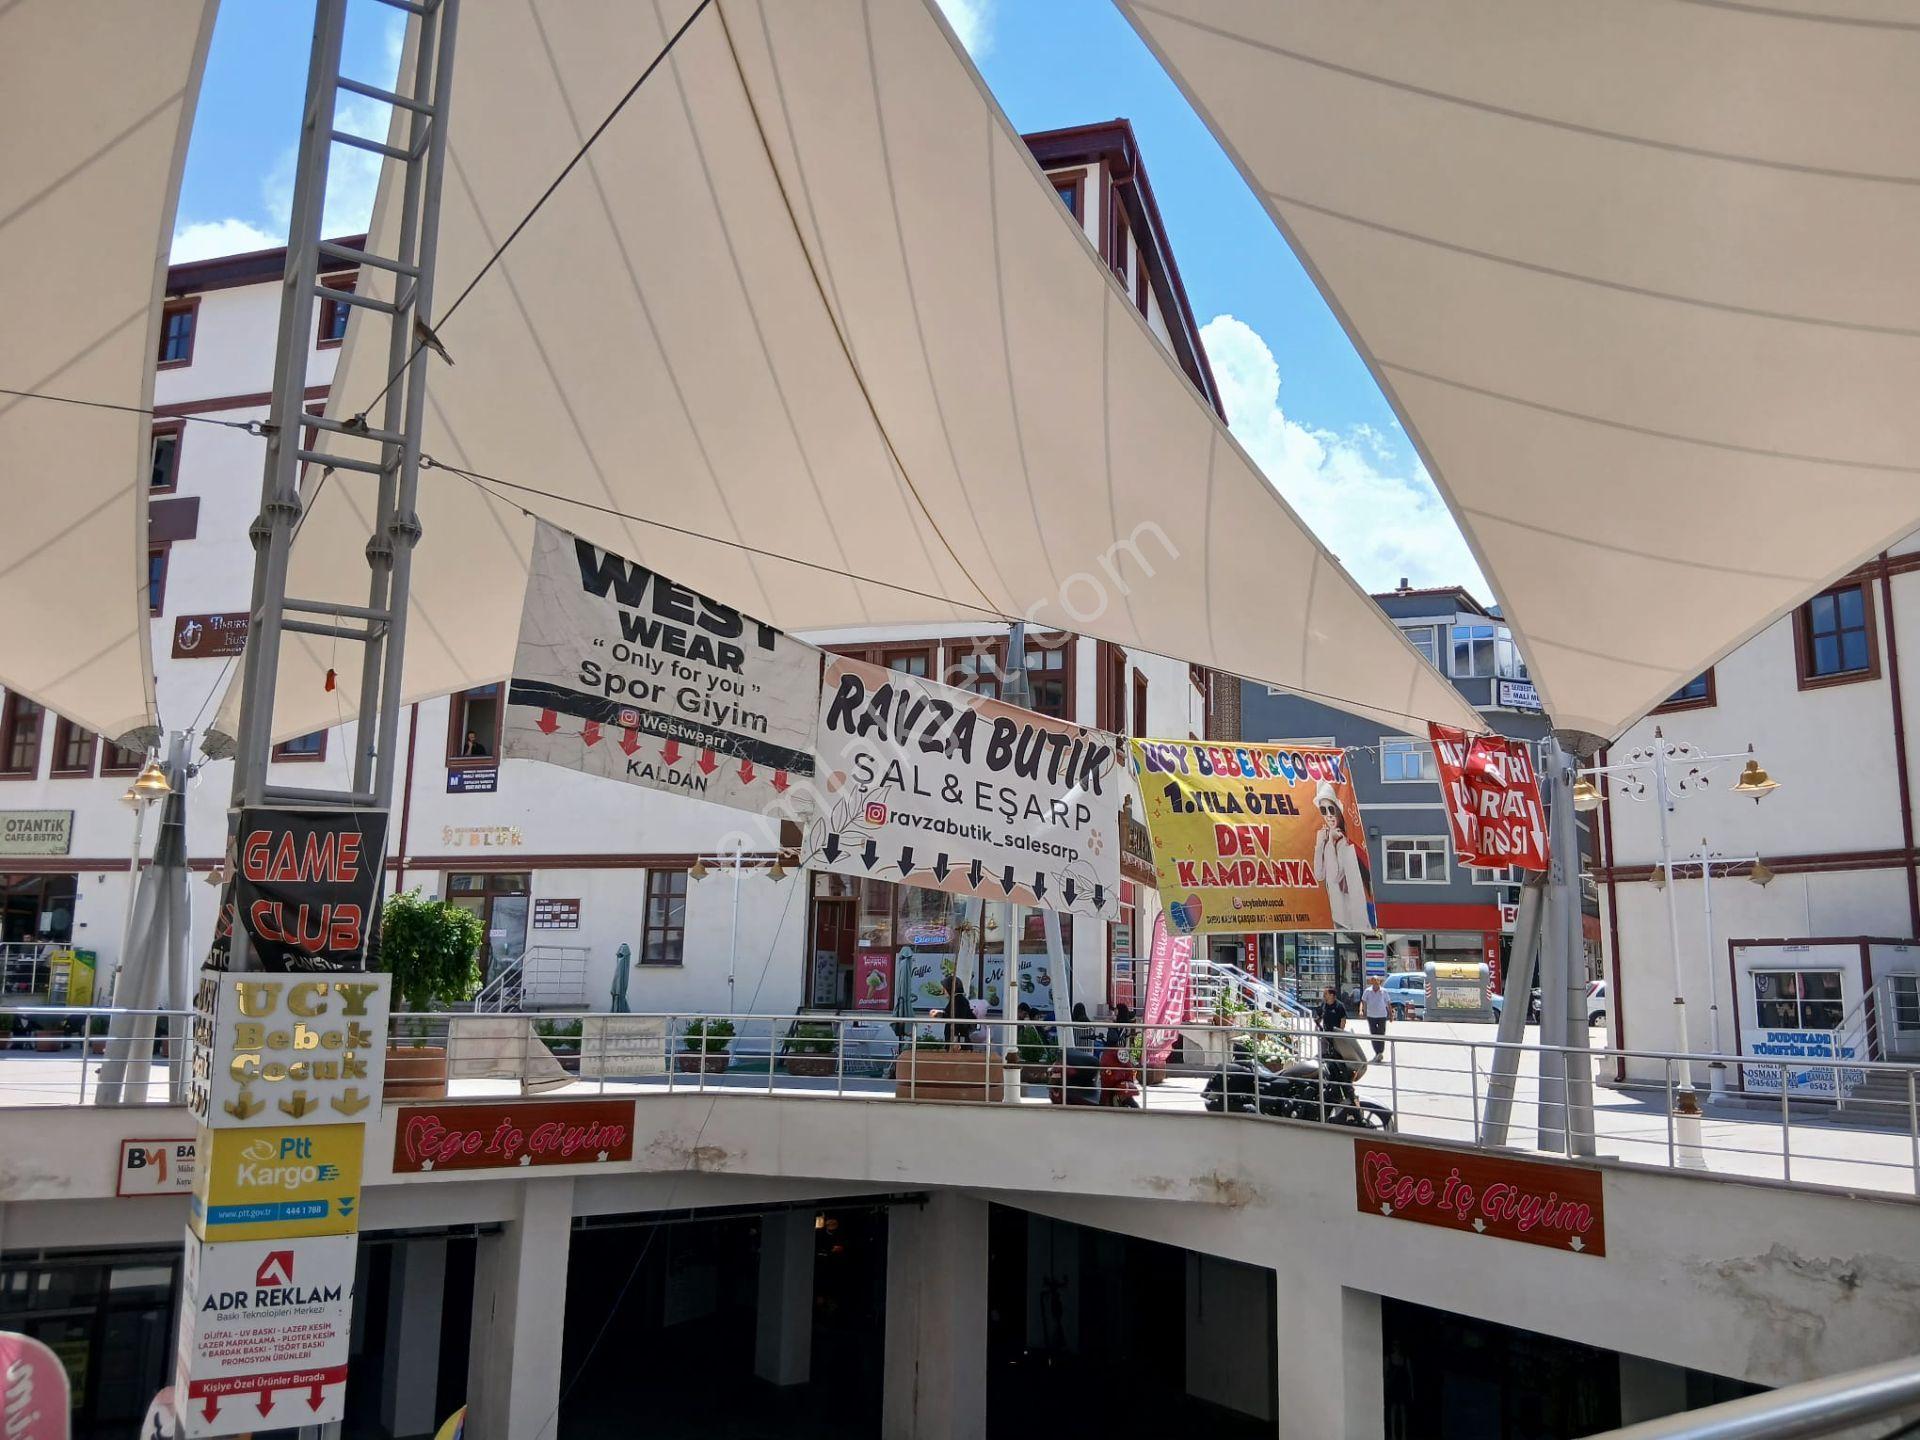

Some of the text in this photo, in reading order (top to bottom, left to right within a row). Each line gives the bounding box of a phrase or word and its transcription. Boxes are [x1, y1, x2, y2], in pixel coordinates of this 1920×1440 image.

[574, 538, 784, 651] WEST
[618, 610, 745, 675] WEAR
[612, 643, 665, 675] Only
[671, 660, 702, 682] for
[707, 674, 745, 697] you
[578, 660, 769, 734] Spor Giyim
[640, 715, 728, 748] Westwearr
[826, 673, 1110, 795] RAVZA BUTİK
[1140, 742, 1189, 774] UCY
[626, 759, 708, 792] KALDAN
[851, 753, 1091, 832] ŞAL & EŞARP
[1244, 786, 1300, 816] ÖZEL
[889, 809, 1079, 862] ravzabutik_salesarp
[1214, 823, 1271, 858] DEV
[242, 829, 362, 883] GAME
[1176, 859, 1319, 888] KAMPANYA
[250, 899, 362, 952] CLUB
[235, 982, 379, 1017] UCY
[234, 1021, 372, 1050] Bebek
[229, 1052, 368, 1087] Çocuk
[280, 1136, 312, 1160] Ptt
[418, 1117, 626, 1162] Ege İç Giyim
[237, 1163, 318, 1189] Kargo
[1374, 1166, 1594, 1233] Ege İç Giyim
[201, 1284, 342, 1312] ADR REKLAM
[293, 1306, 325, 1316] Merkezi
[252, 1326, 276, 1336] BASKI
[282, 1324, 307, 1334] LAZER
[208, 1347, 242, 1358] BARDAK
[221, 1355, 271, 1367] PROMOSYON
[233, 1379, 255, 1390] Özel
[257, 1376, 291, 1387] Ürünler
[293, 1372, 325, 1382] Burada
